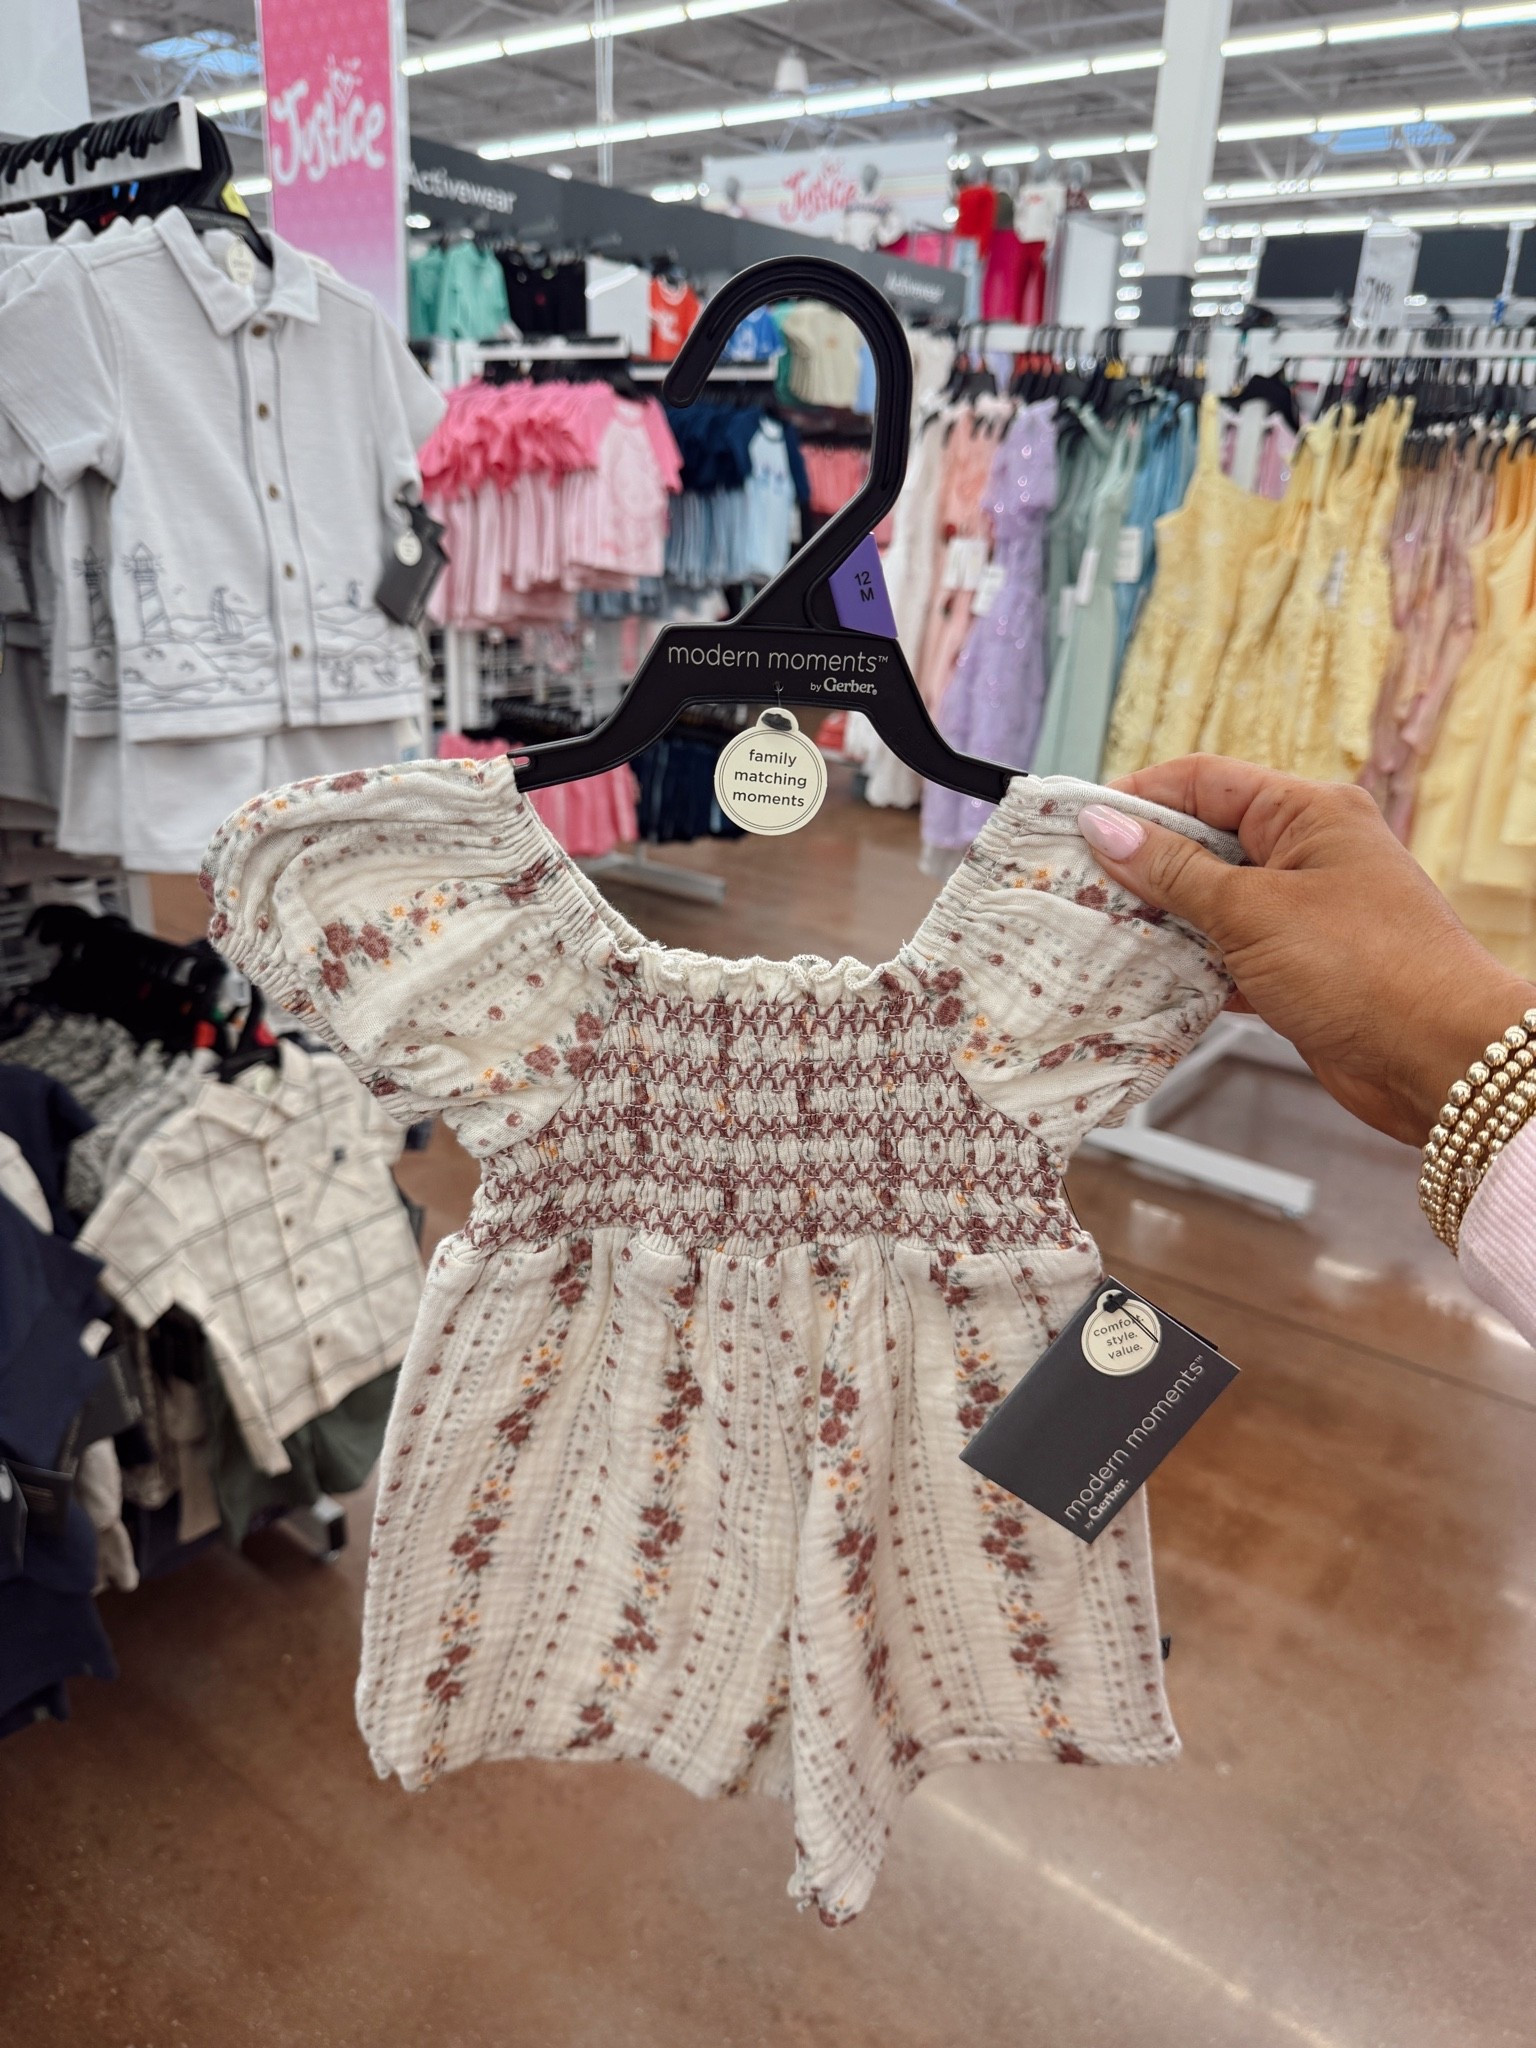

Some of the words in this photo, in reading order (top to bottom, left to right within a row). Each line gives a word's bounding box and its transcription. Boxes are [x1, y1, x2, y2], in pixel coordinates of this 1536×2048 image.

[270, 72, 386, 184] Justice
[854, 571, 872, 586] 12
[860, 587, 875, 602] M
[668, 643, 760, 668] modern
[810, 682, 822, 693] by
[749, 749, 797, 768] family
[734, 771, 807, 789] matching
[732, 791, 805, 807] moments
[1106, 1331, 1138, 1347] style.
[1108, 1343, 1143, 1360] value.
[1064, 1448, 1130, 1520] modern
